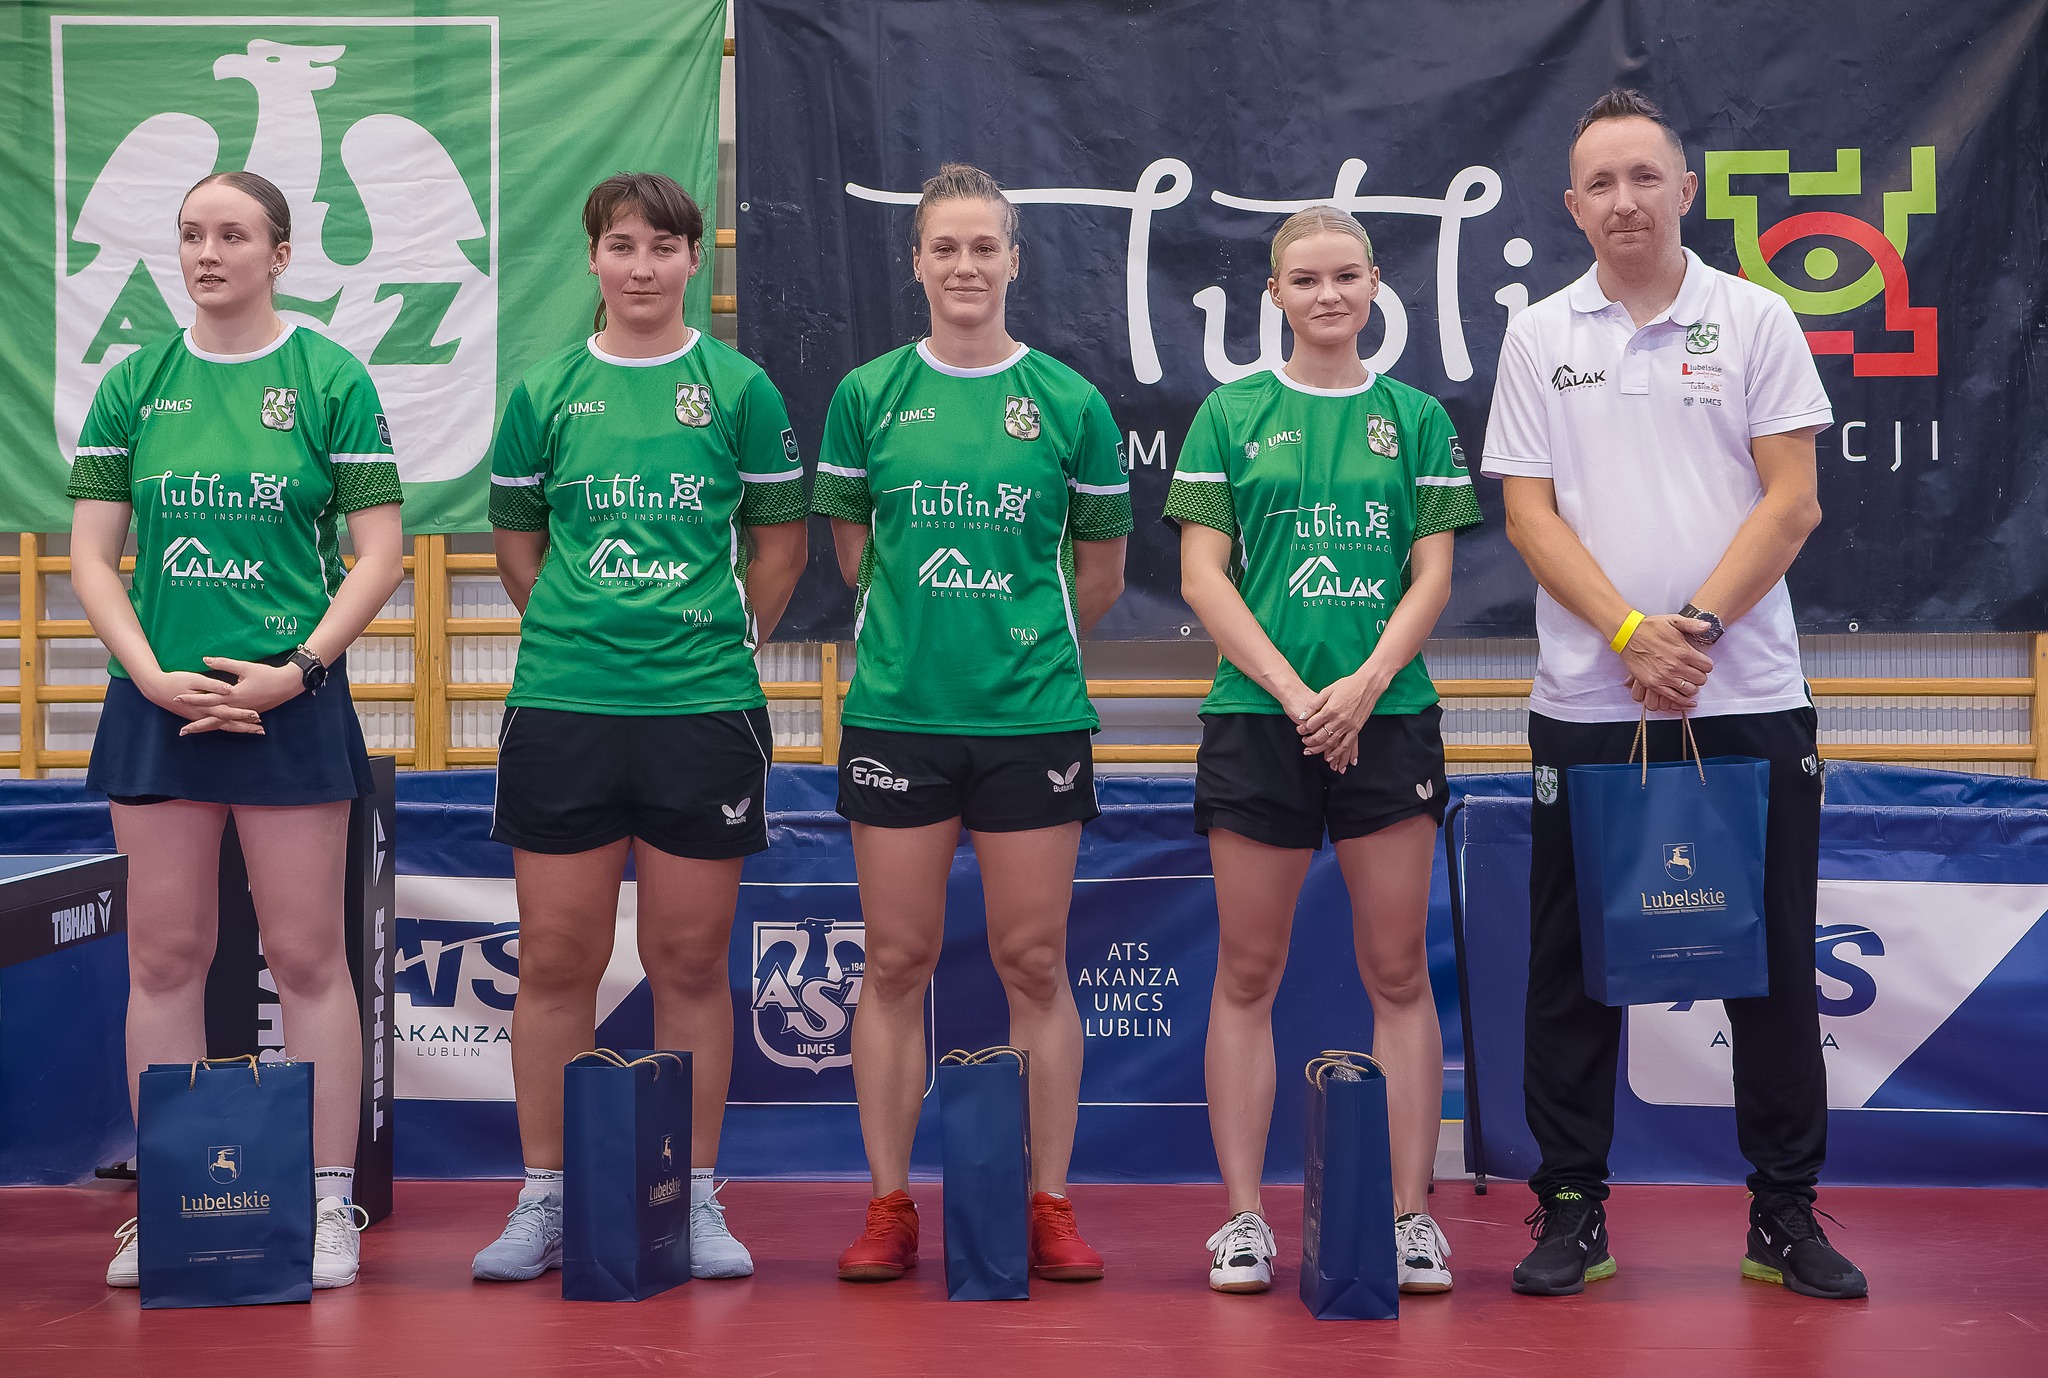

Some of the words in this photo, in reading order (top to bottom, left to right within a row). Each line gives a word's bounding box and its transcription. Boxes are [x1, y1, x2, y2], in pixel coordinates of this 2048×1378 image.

[154, 398, 193, 412] UMCS
[568, 400, 606, 415] UMCS
[1699, 397, 1722, 407] UMCS
[899, 407, 936, 423] UMCS
[1267, 428, 1302, 447] UMCS
[161, 511, 206, 520] MIASTO
[214, 513, 284, 524] INSPIRACJI
[634, 513, 704, 525] INSPIRACJI
[911, 521, 956, 529] MIASTO
[171, 579, 266, 590] DEVELOPMENT
[852, 766, 910, 792] Enea
[1640, 887, 1726, 909] Lubelskie
[51, 902, 96, 945] TIBHAR
[1107, 942, 1150, 961] ATS
[1078, 967, 1180, 987] AKANZA
[1094, 993, 1164, 1012] UMCS
[373, 906, 386, 1143] TIBHAR
[1086, 1018, 1171, 1037] LUBLIN
[417, 1046, 480, 1058] LUBLIN
[797, 1043, 836, 1055] UMCS
[649, 1176, 681, 1201] Lubelskie
[181, 1190, 271, 1212] Lubelskie
